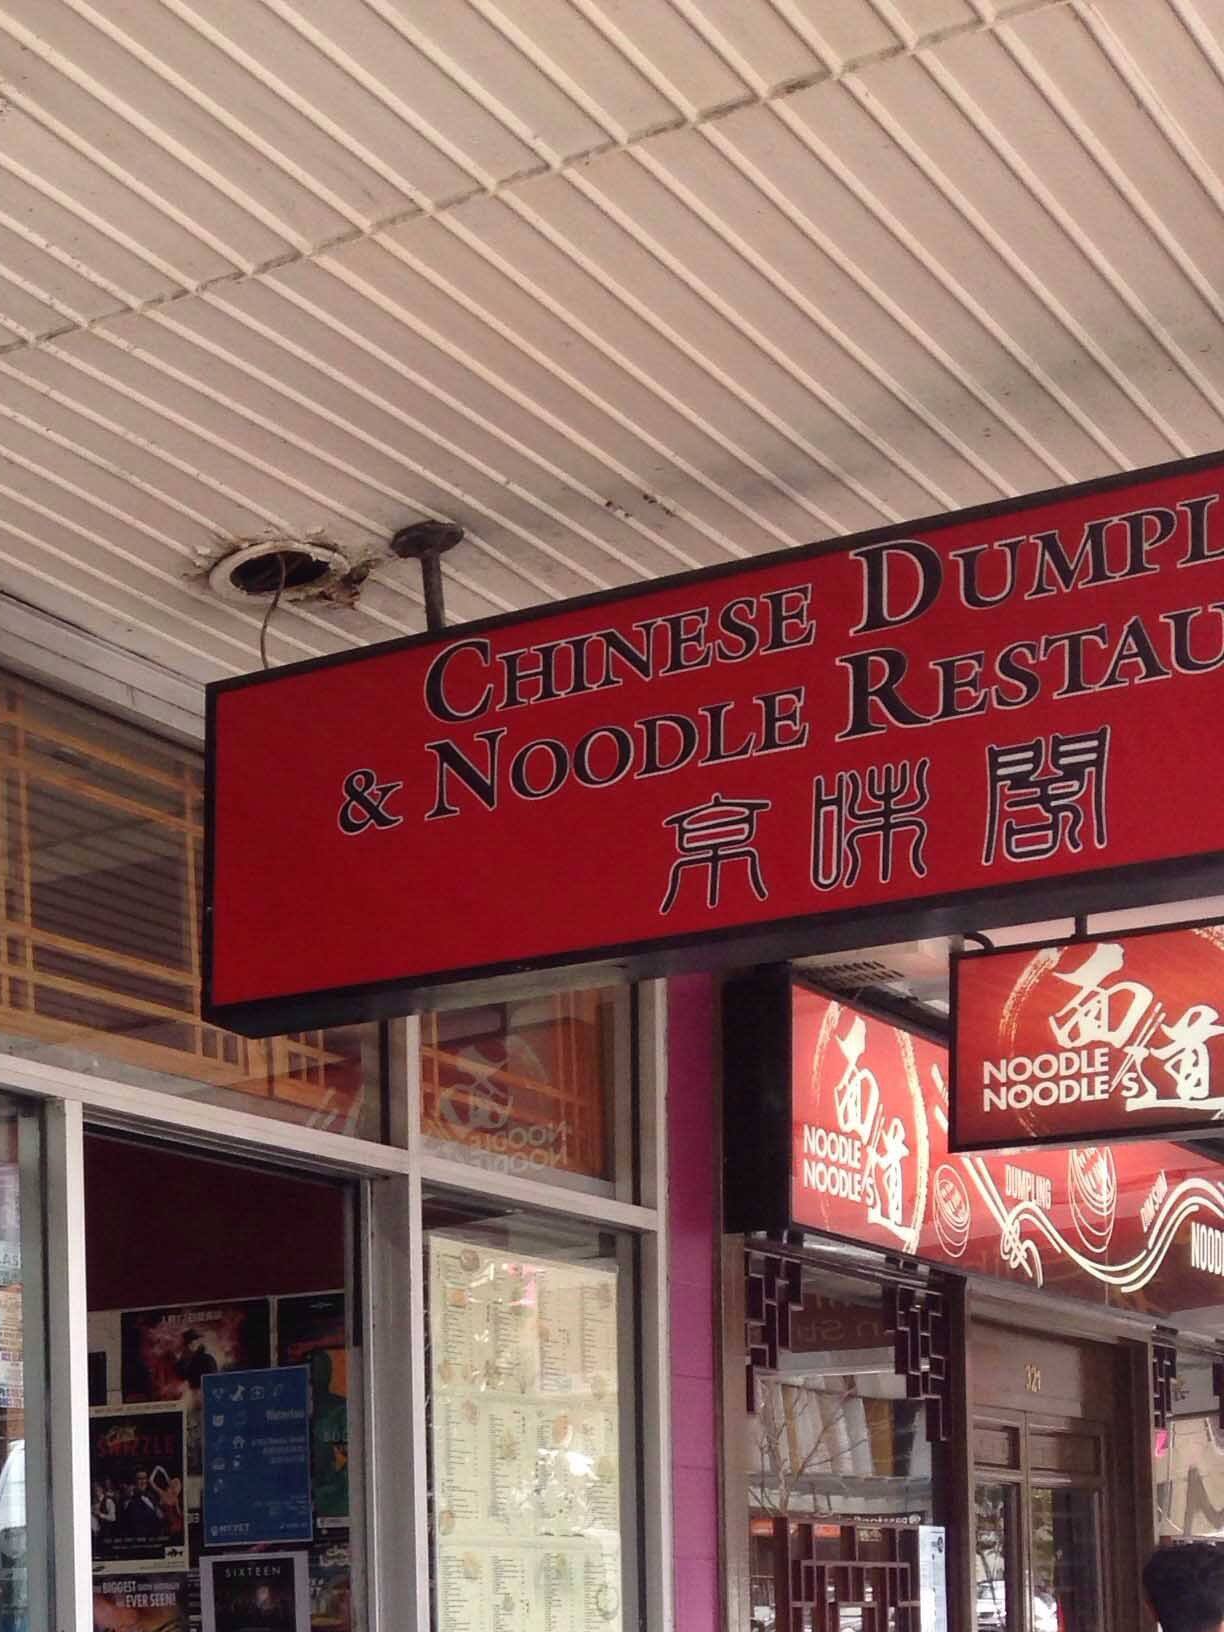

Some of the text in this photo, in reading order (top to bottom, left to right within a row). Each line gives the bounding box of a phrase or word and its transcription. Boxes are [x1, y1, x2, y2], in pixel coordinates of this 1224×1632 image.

[423, 584, 816, 724] CHINESE
[337, 601, 1224, 836] & NOODLE RESTAU
[983, 1047, 1110, 1084] NOODLE
[803, 1124, 863, 1170] NOODLE
[1005, 1164, 1053, 1211] DUMPLING
[1191, 1221, 1224, 1277] NOOD
[102, 1580, 137, 1594] BIGGEST
[226, 1566, 281, 1578] SIXTEEN
[126, 1592, 148, 1608] EVER
